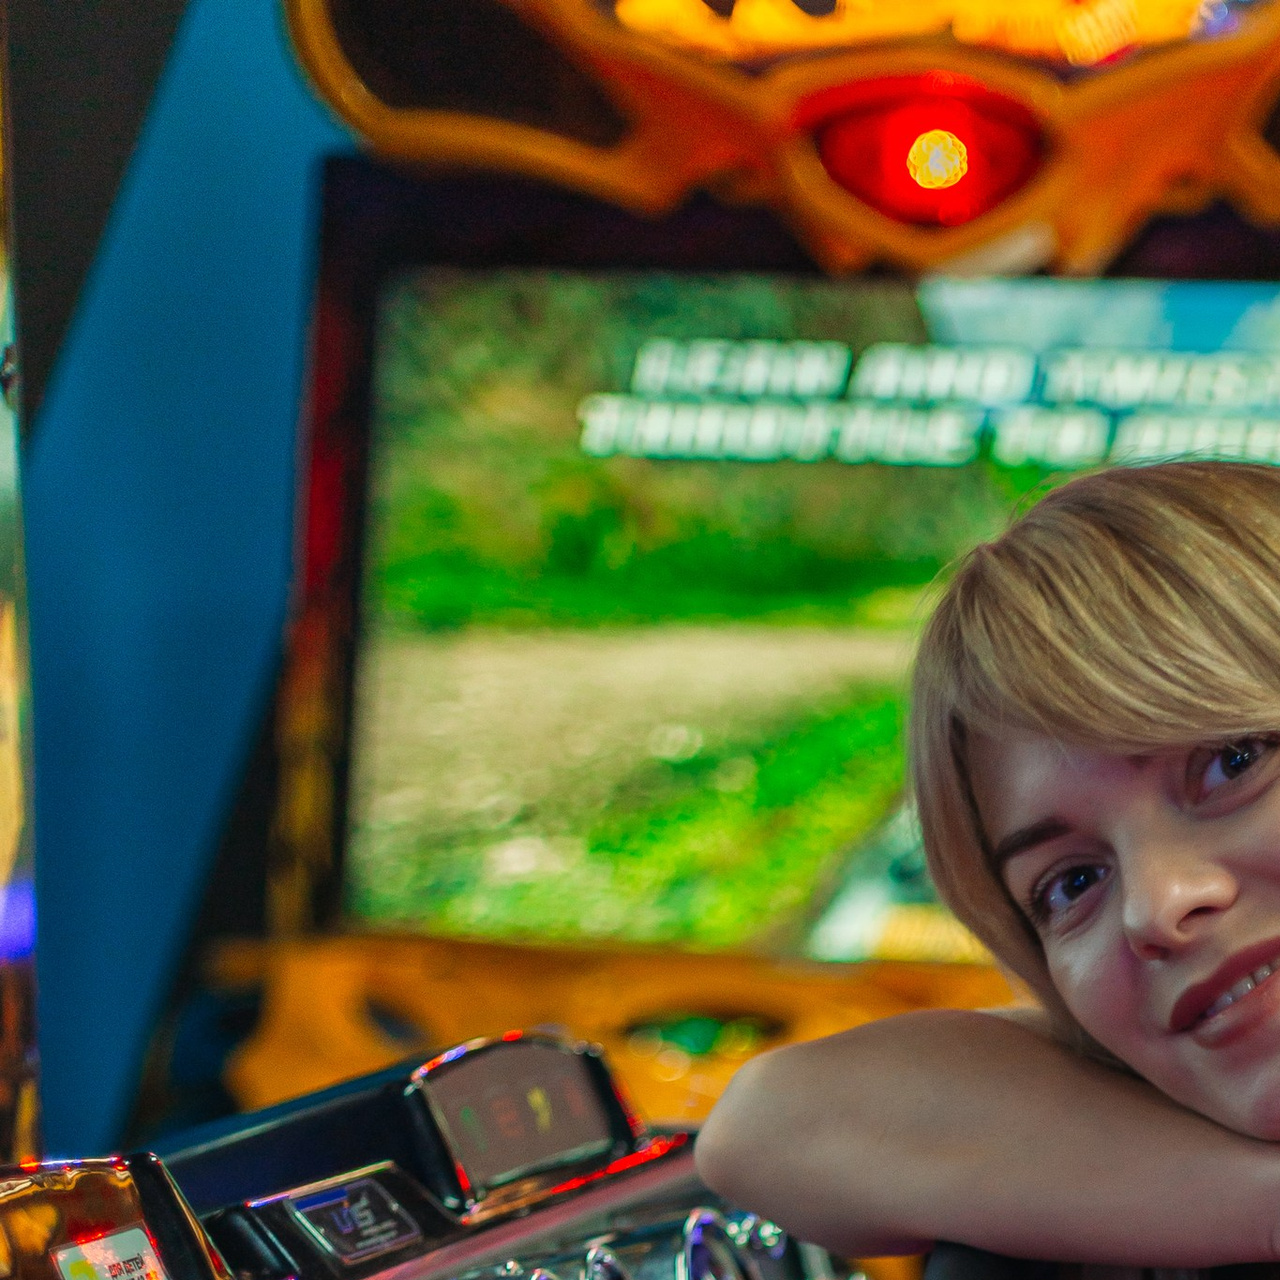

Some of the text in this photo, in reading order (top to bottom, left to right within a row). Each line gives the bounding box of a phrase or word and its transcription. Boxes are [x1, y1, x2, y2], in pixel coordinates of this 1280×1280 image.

[631, 336, 854, 397] LEAN
[846, 341, 1037, 403] AND
[575, 392, 982, 467] THROTTLE
[991, 405, 1112, 470] TO
[108, 1254, 145, 1280] ДЛЯ ДЕТЕЙ
